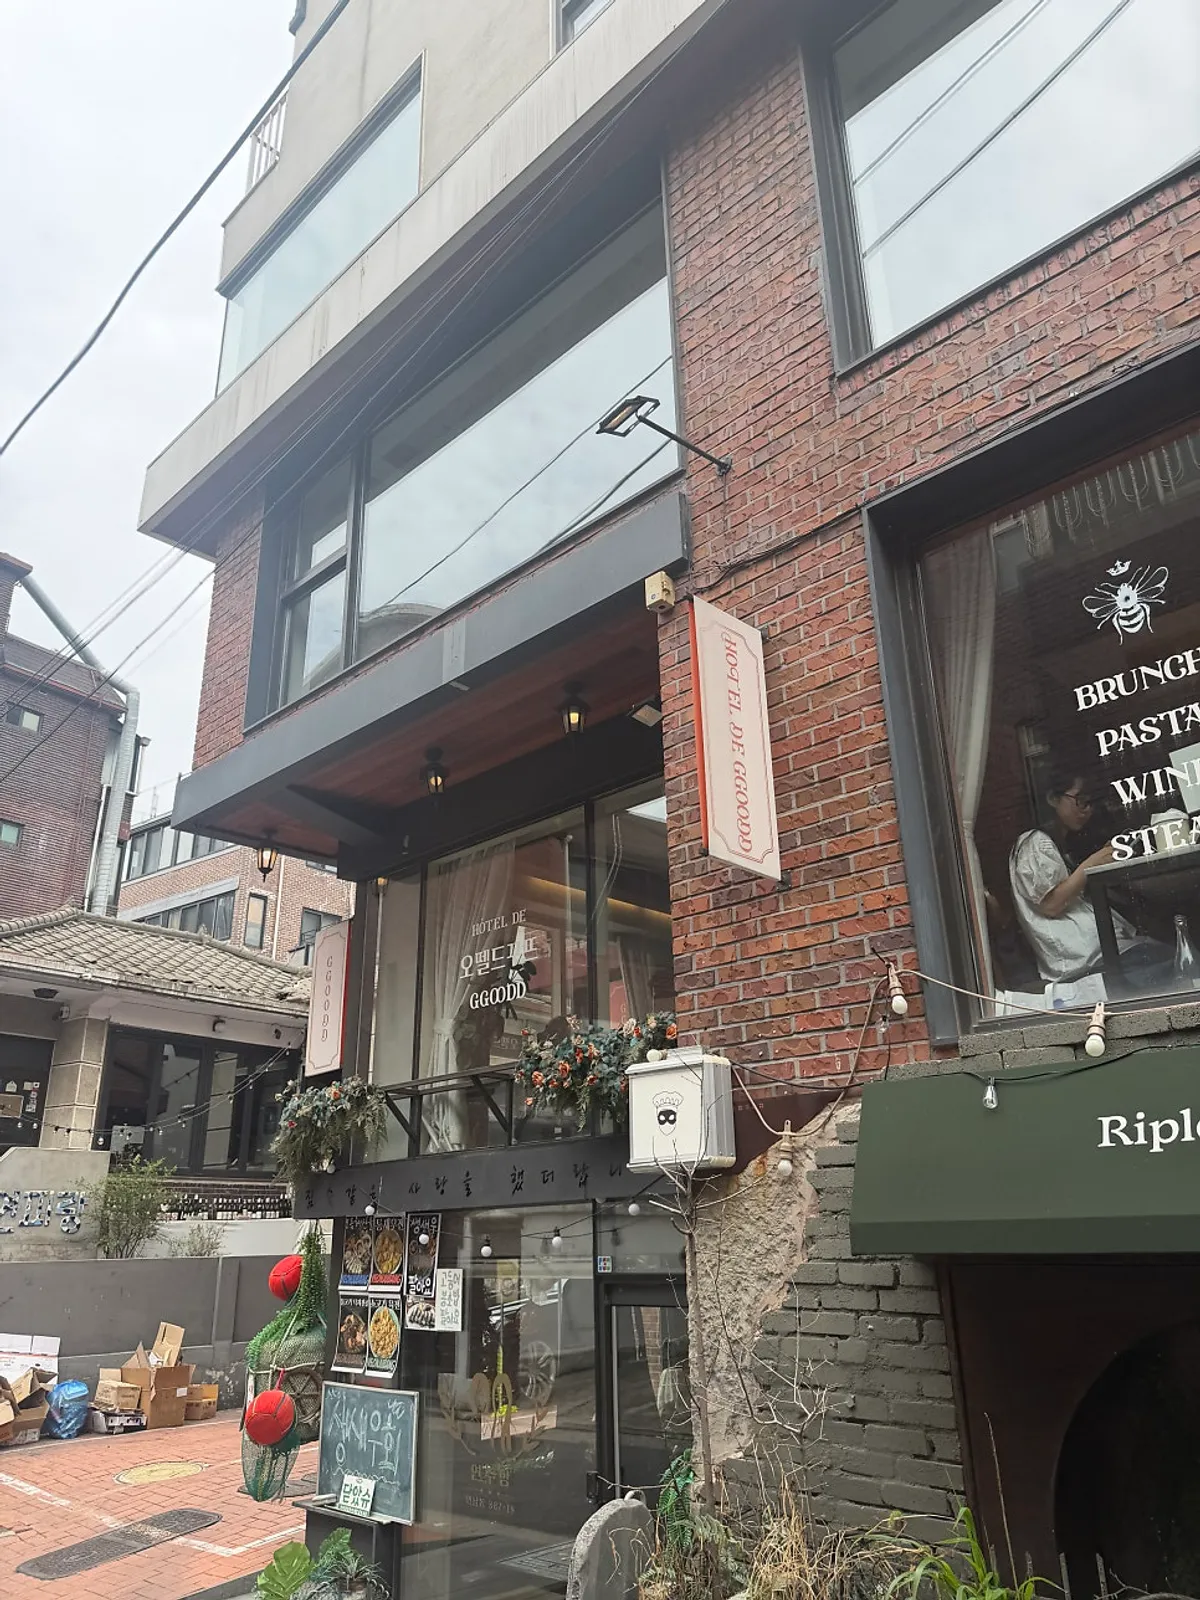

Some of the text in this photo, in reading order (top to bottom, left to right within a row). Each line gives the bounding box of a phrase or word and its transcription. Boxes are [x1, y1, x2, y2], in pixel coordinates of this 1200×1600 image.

[729, 721, 746, 757] DE
[733, 760, 753, 854] GGOODD
[512, 908, 527, 925] DE
[469, 980, 527, 1010] GGOODD
[1097, 1107, 1200, 1153] Ripl
[408, 1168, 474, 1199] 사랑을
[409, 1216, 438, 1235] 생새우
